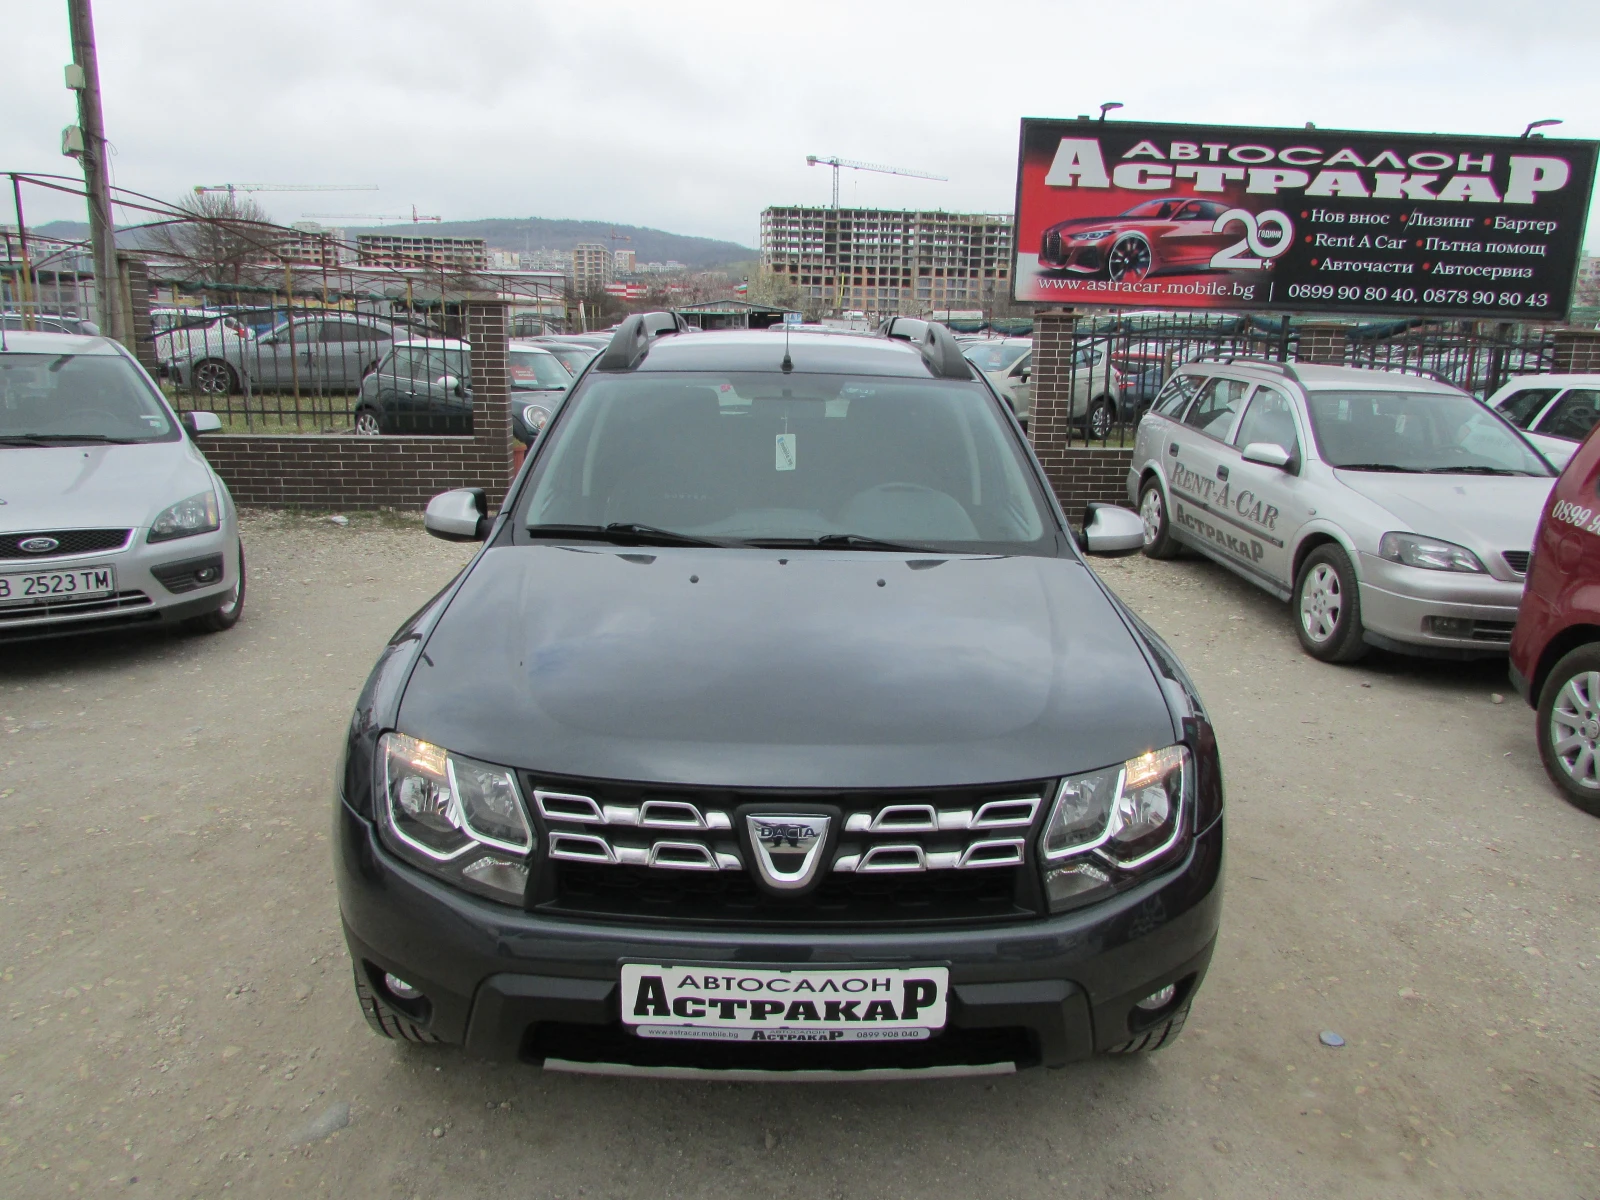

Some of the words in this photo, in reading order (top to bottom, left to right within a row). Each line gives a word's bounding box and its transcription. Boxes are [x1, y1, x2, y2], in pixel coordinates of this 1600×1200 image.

[1122, 140, 1493, 172] АВТОСАЛОН
[1311, 209, 1345, 223] Нов
[1348, 213, 1390, 225] внос
[1408, 212, 1474, 228] Лизинг
[1493, 216, 1557, 234] Бартер
[1314, 233, 1355, 248] Rent
[1357, 235, 1371, 249] A
[1375, 235, 1407, 250] Car
[1425, 237, 1481, 252] Пътна
[1484, 242, 1546, 257] помощ
[1320, 257, 1414, 274] Авточасти
[1431, 261, 1532, 280] Автосервиз
[1037, 277, 1255, 300] www.astracar.mobile.bg
[1288, 284, 1333, 299] 0899
[1337, 285, 1360, 300] 90
[1364, 287, 1387, 301] 80
[1391, 288, 1418, 303] 40,
[1423, 289, 1468, 304] 0878
[1472, 291, 1494, 305] 90
[1498, 292, 1521, 306] 80
[1525, 293, 1548, 307] 43
[1552, 499, 1592, 527] 0899
[1586, 514, 1600, 536] 9
[23, 573, 77, 595] 2523
[81, 570, 109, 590] TM
[760, 827, 816, 839] DACIA
[648, 1028, 739, 1039] www.astracar.mobile.bg
[856, 1031, 879, 1039] 0899
[882, 1031, 899, 1039] 908
[901, 1030, 919, 1038] 040
